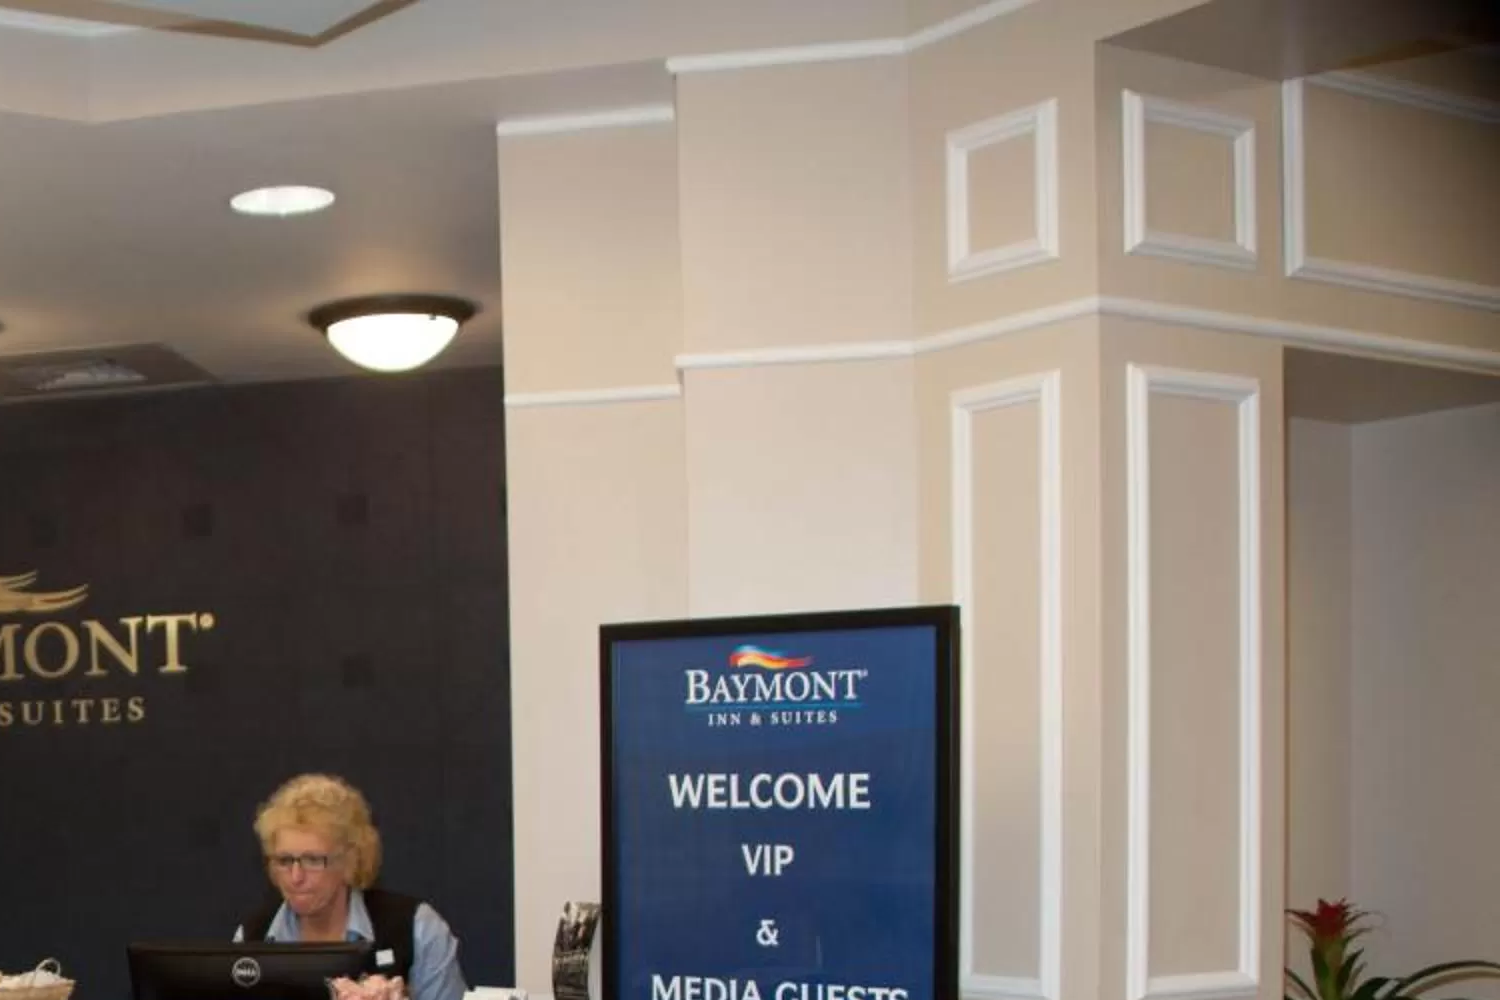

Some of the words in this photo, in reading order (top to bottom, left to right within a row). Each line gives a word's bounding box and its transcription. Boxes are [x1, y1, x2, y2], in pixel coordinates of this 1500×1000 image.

[685, 668, 862, 704] BAYMONT
[708, 712, 741, 727] INN
[750, 712, 761, 726] &
[770, 710, 838, 725] SUITES
[668, 772, 871, 810] WELCOME
[741, 843, 794, 877] VIP
[756, 918, 779, 947] &
